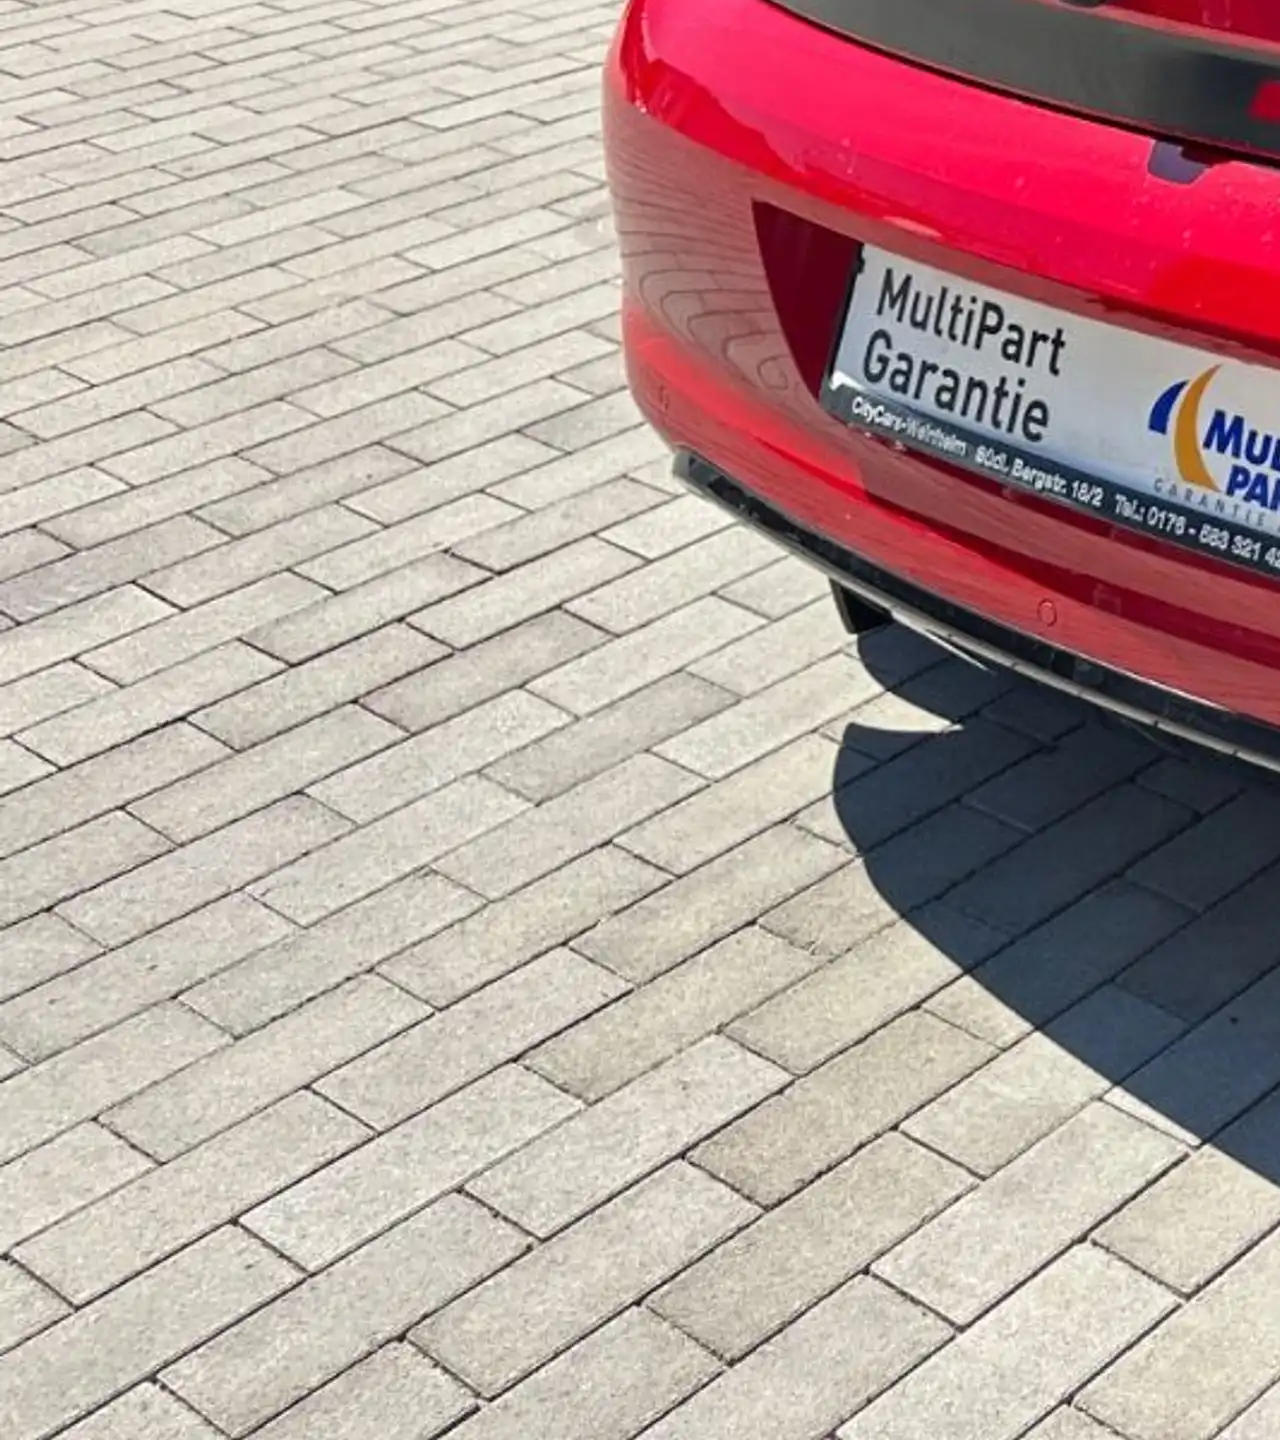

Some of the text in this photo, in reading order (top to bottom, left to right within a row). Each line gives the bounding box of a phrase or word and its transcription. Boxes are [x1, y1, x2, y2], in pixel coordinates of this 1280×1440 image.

[876, 267, 1066, 376] MultiPart
[864, 329, 1050, 442] Garantie
[1154, 477, 1266, 526] GARANTIE
